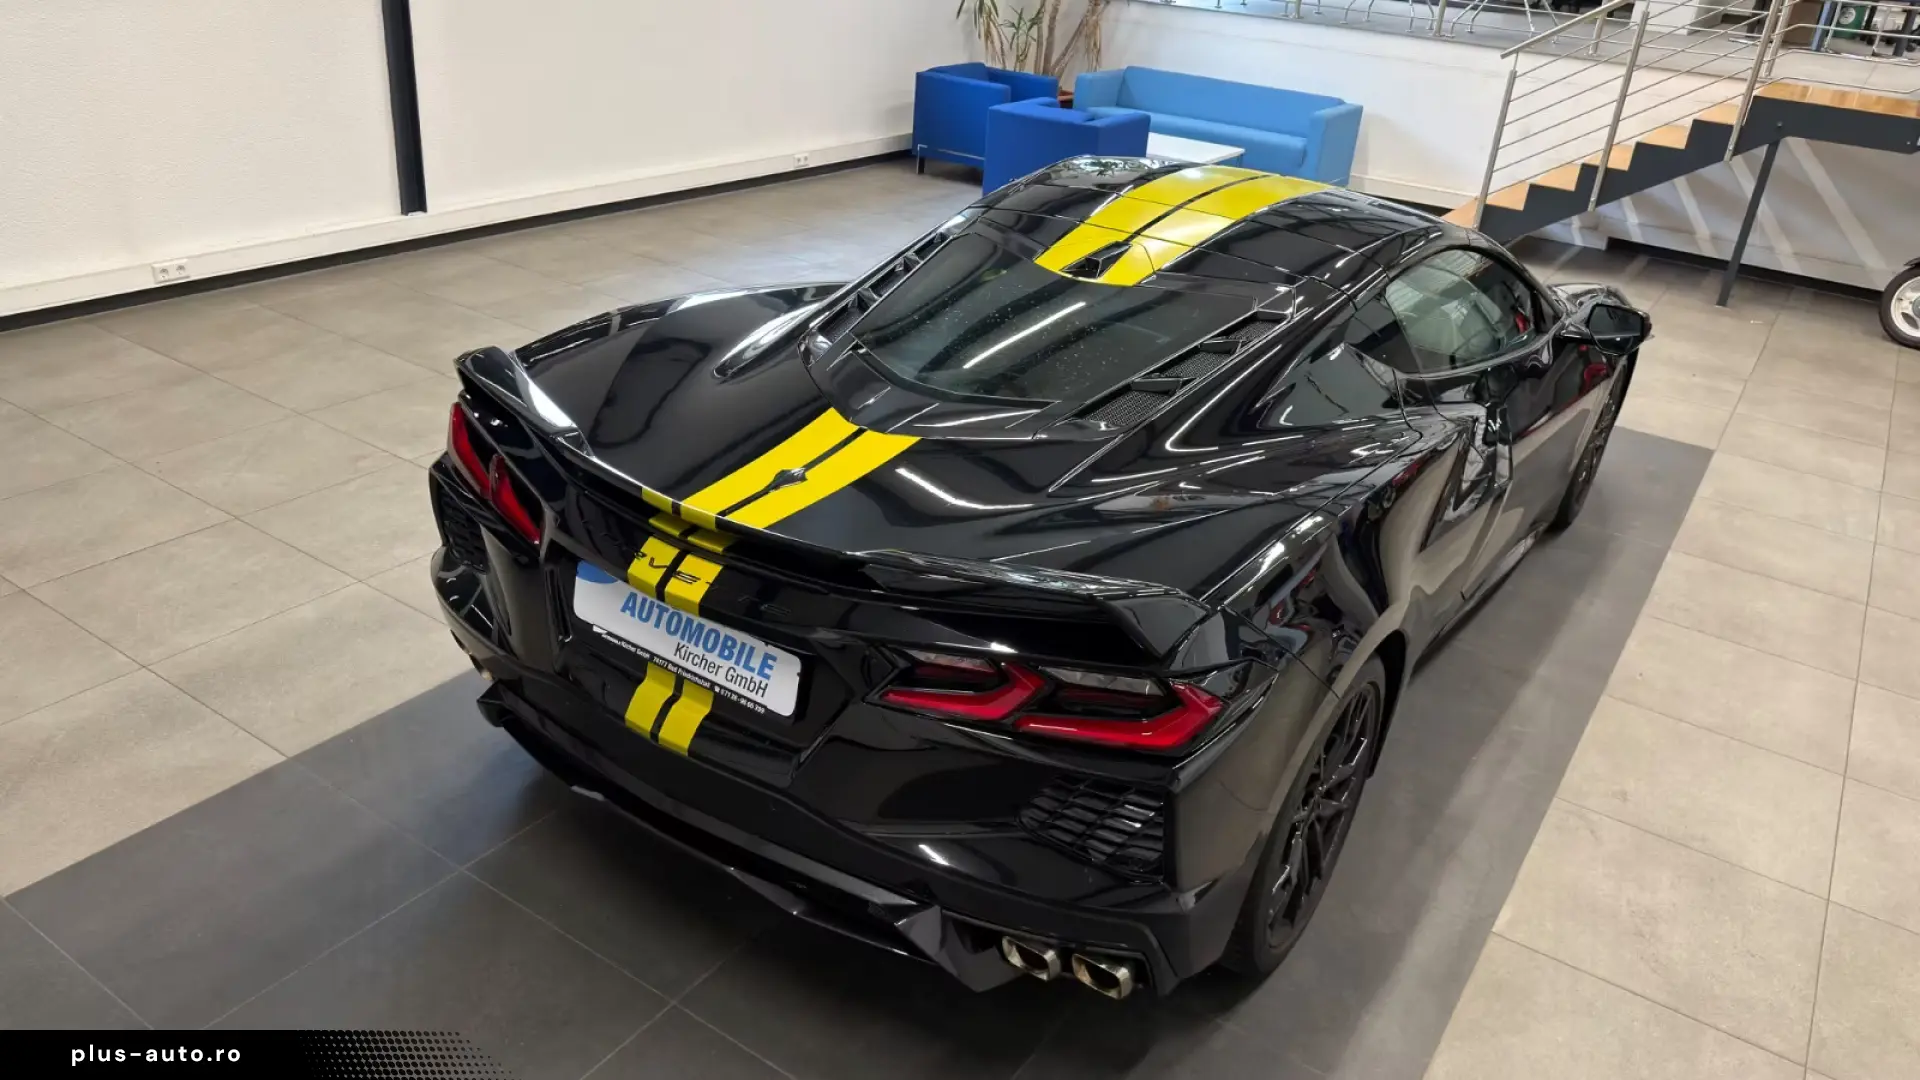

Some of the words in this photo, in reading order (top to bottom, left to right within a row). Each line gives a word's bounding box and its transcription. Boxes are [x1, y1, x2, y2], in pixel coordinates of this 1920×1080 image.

[620, 591, 778, 681] AUTOMOBILE
[673, 641, 723, 677] Kircher
[724, 666, 769, 698] GmbH
